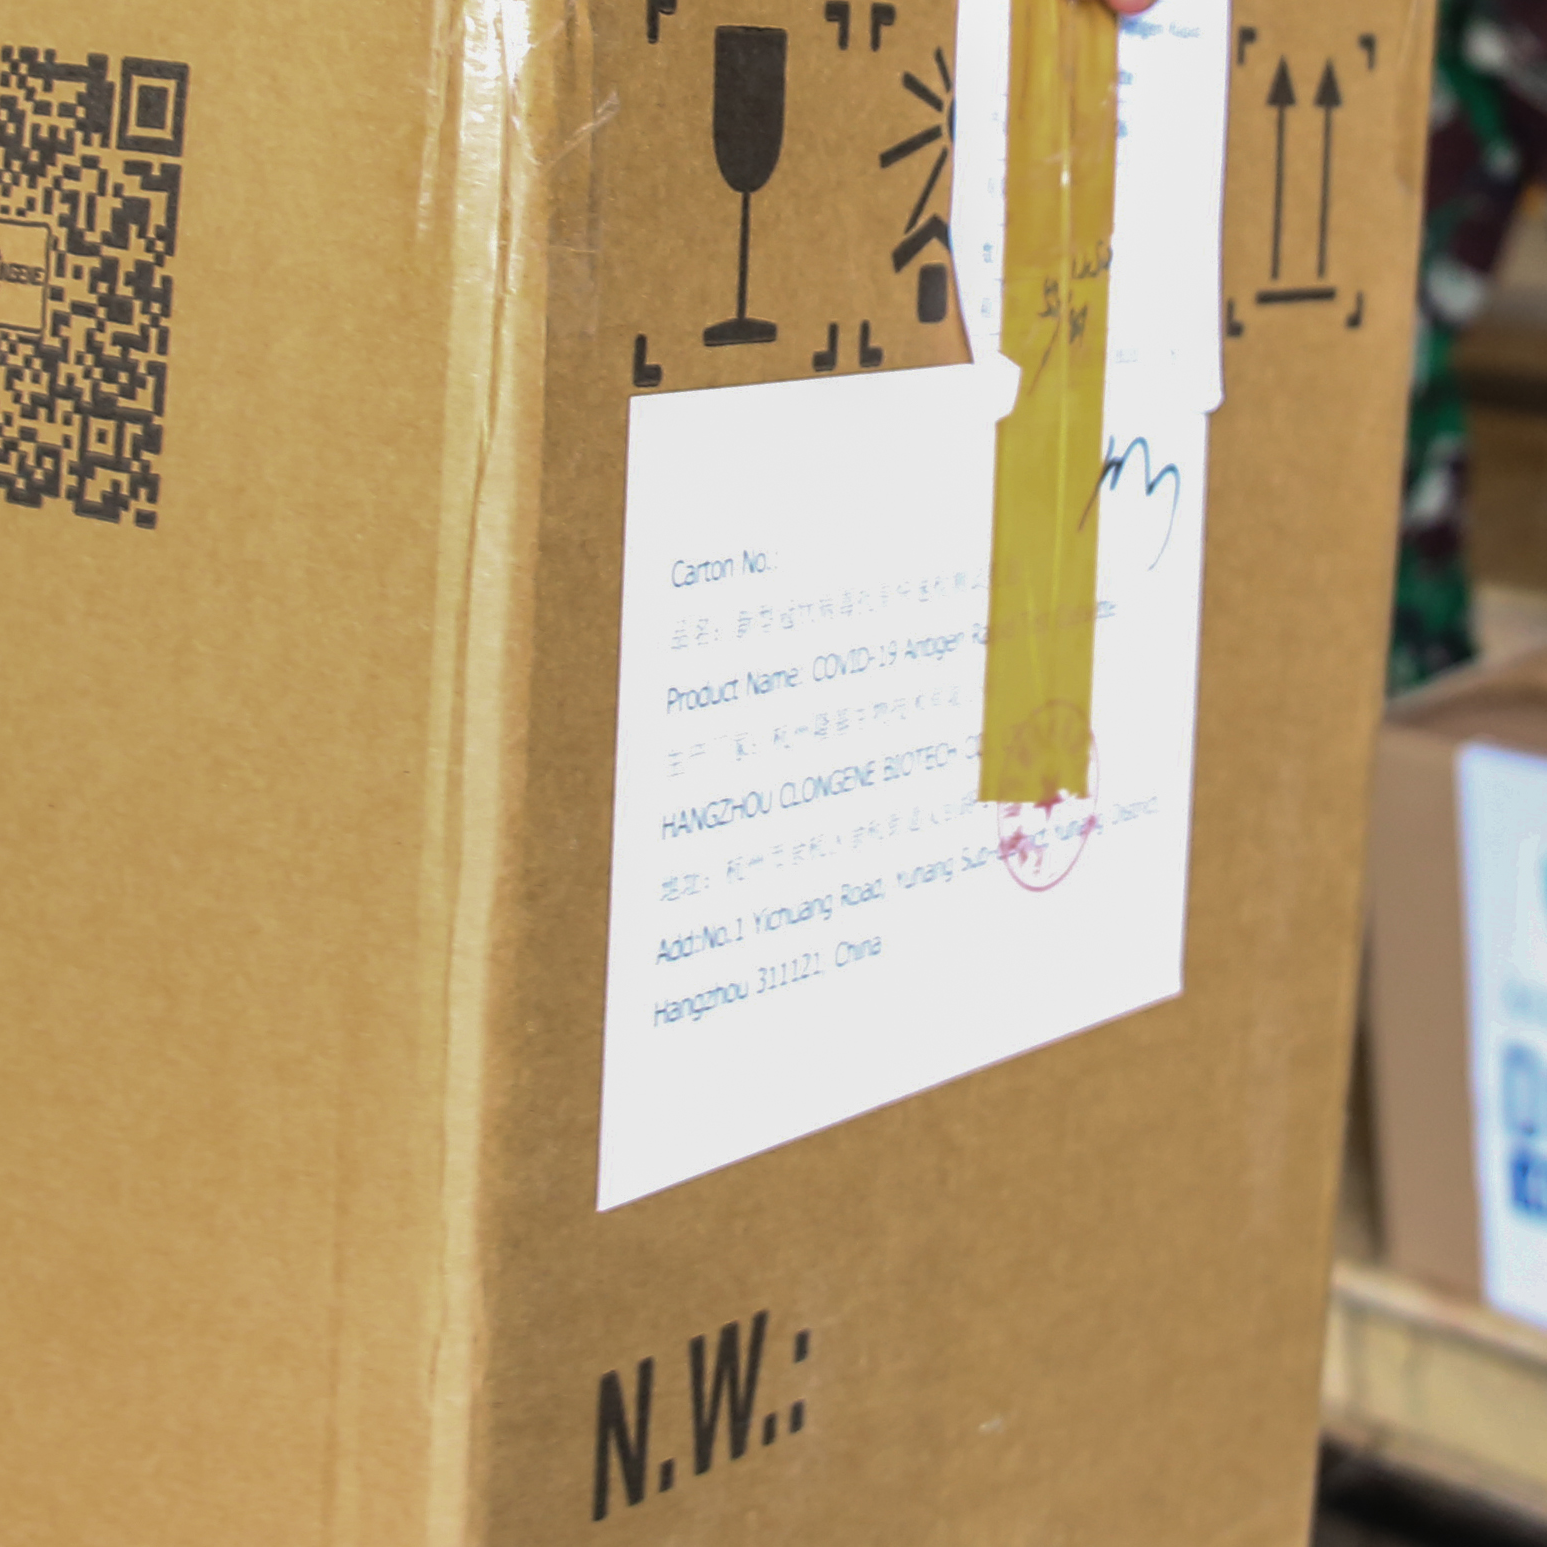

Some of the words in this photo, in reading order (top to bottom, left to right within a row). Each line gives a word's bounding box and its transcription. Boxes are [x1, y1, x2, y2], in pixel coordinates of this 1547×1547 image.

[671, 558, 734, 588] Carton
[665, 678, 739, 714] Product
[812, 639, 898, 682] COVID-19
[661, 789, 773, 840] HANGZHOU
[779, 759, 876, 810] CLONGENE
[653, 980, 749, 1028] Hangzhou
[835, 936, 883, 968] China
[592, 1309, 811, 1522] N.W.:
